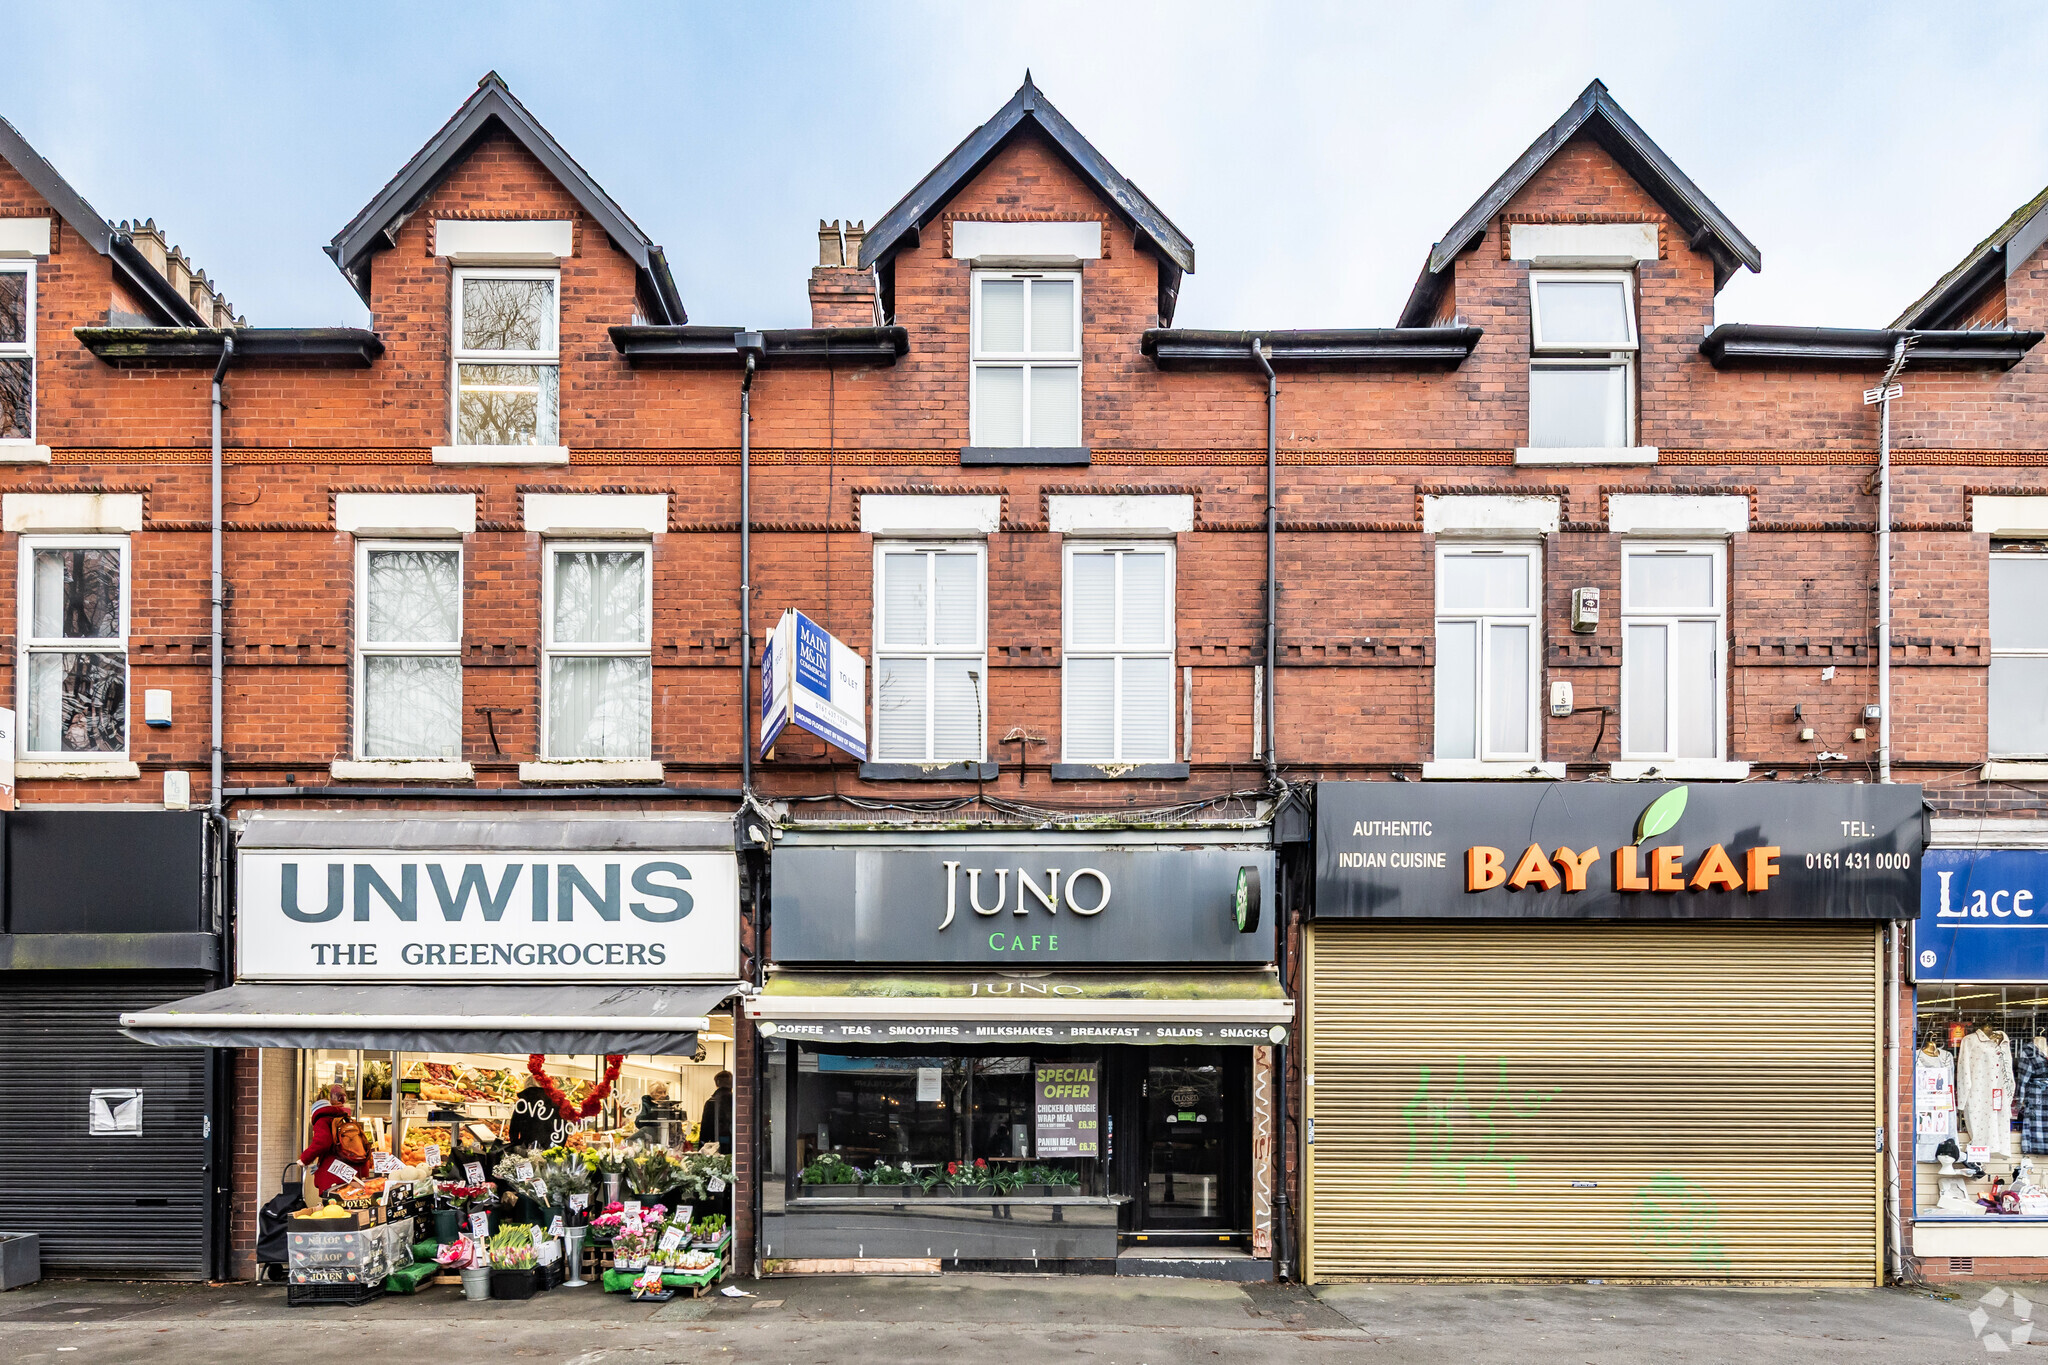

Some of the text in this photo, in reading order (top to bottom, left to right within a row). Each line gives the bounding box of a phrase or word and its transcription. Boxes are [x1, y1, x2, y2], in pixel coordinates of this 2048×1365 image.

[800, 625, 827, 655] MAIN
[840, 671, 858, 691] TO LET
[795, 711, 812, 726] GROUND
[811, 720, 824, 732] FLOOR
[823, 726, 832, 737] UNIT
[1352, 821, 1432, 837] AUTHENTIC
[1840, 820, 1875, 837] TEL:
[1339, 852, 1446, 868] INDIAN CUISINE
[1467, 843, 1781, 893] BAY LEAF
[1806, 852, 1911, 870] 0161 431 0000
[281, 862, 694, 923] UNWINS
[938, 861, 1112, 931] JUNO
[1936, 871, 2034, 918] Lace
[989, 932, 1059, 951] CAFE
[311, 943, 666, 965] THE GREENGROCERS
[1921, 954, 1936, 964] 151
[970, 982, 1084, 997] JUNO
[777, 1024, 1268, 1038] COFFEE TEAS SMOOTHIES MILKSHAKES BREAKFAST SALADS SNACKS
[1037, 1068, 1096, 1082] SPECIAL
[1044, 1084, 1090, 1098] OFFER
[505, 1094, 554, 1120] ove
[1037, 1104, 1096, 1113] CHICKEN OR VEGGIE
[1037, 1114, 1074, 1123] WRAP MEAL
[1078, 1120, 1097, 1129] £6.99
[1037, 1137, 1077, 1146] PANINI MEAL
[1079, 1142, 1097, 1151] £6.75
[341, 1199, 372, 1208] JOYEN
[311, 1272, 342, 1280] JOYEN
